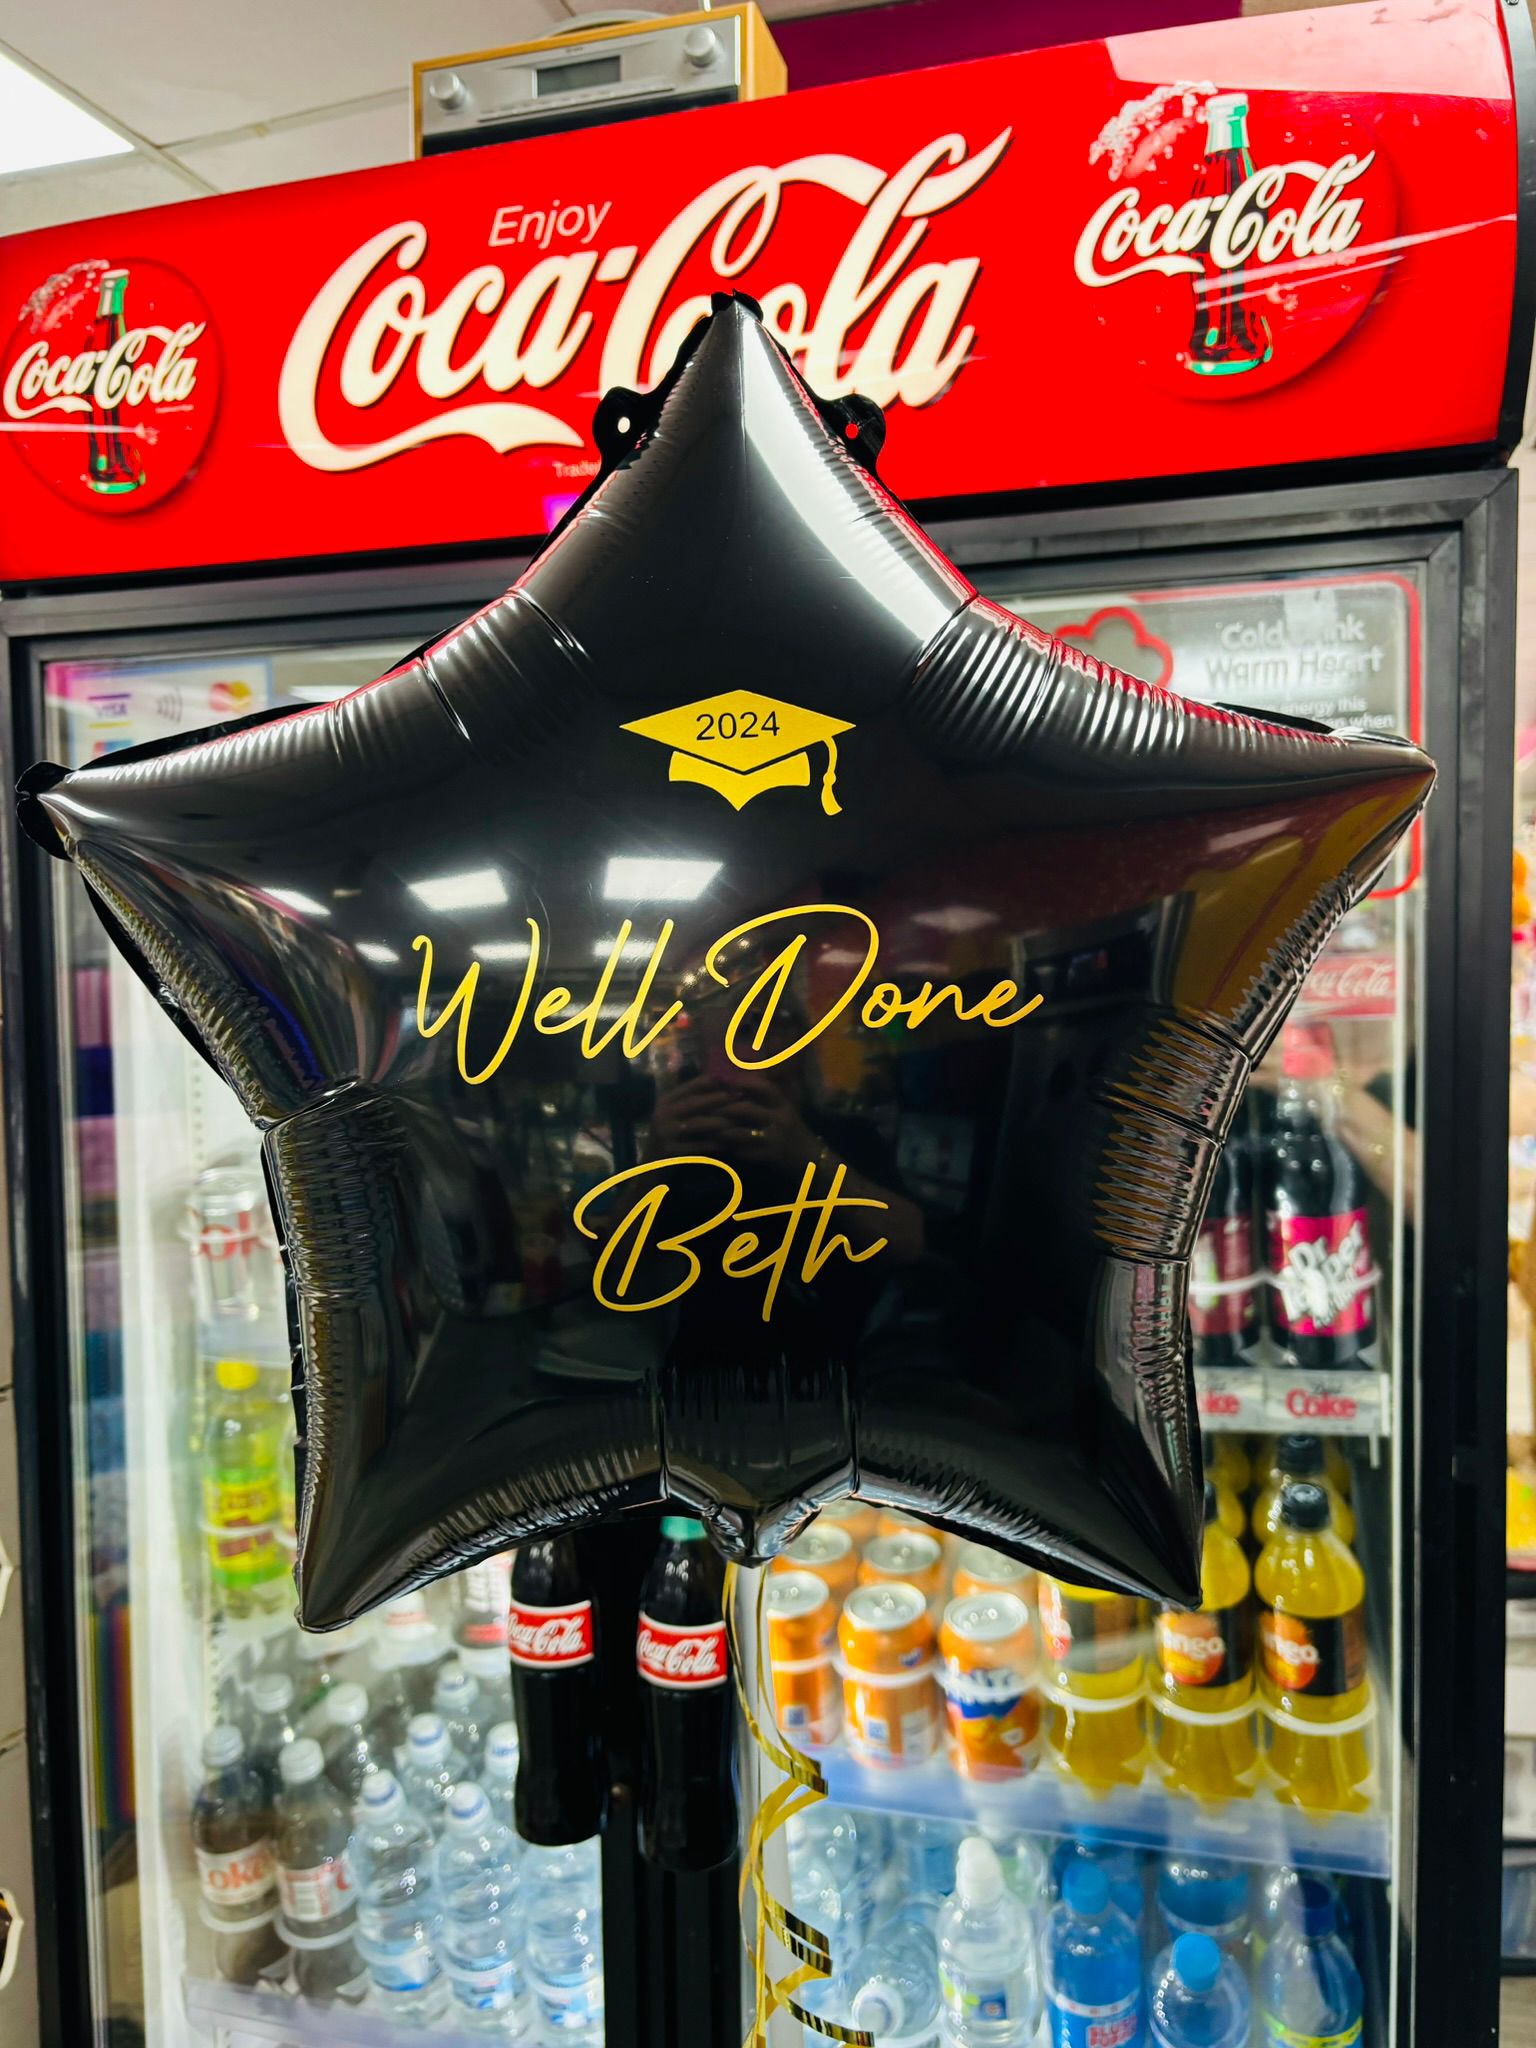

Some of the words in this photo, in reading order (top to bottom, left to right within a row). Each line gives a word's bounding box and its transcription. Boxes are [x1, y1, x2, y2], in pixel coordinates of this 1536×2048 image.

[488, 201, 612, 250] Enjoy
[1074, 150, 1376, 288] Coca-Cola
[278, 126, 1013, 472] Coca-Cola
[3, 321, 207, 420] Coca-Cola
[551, 459, 602, 478] Trade
[696, 710, 780, 740] 2024
[411, 918, 685, 1086] Well
[705, 903, 1044, 1071] Done
[572, 1155, 889, 1323] Beth
[1286, 1387, 1358, 1420] Coke
[636, 1629, 721, 1676] Coca-Cola
